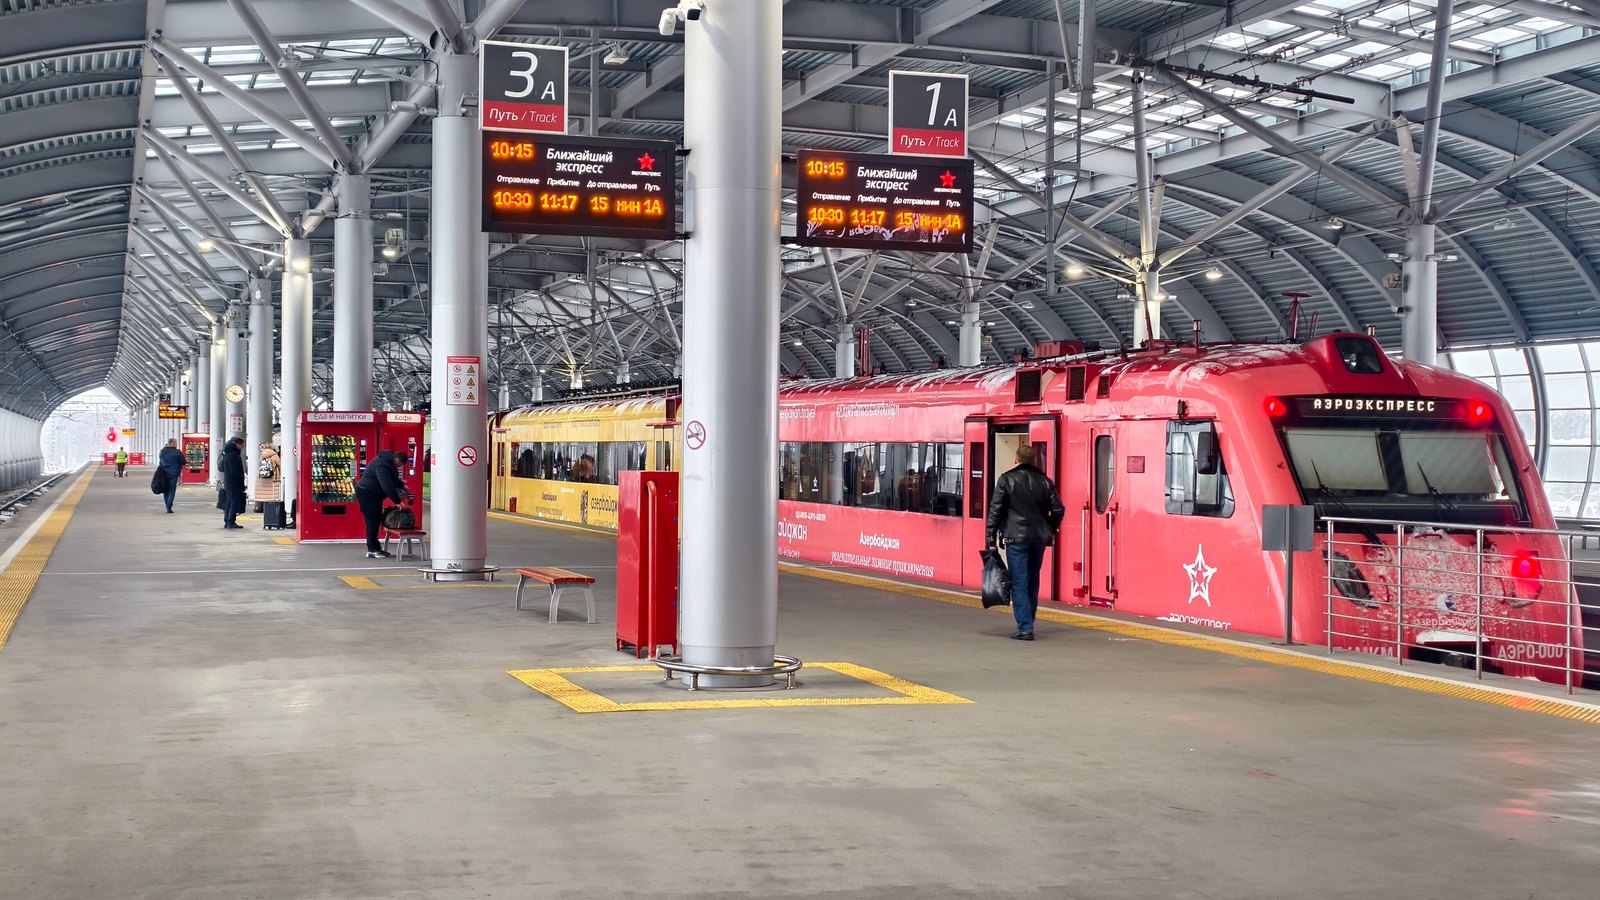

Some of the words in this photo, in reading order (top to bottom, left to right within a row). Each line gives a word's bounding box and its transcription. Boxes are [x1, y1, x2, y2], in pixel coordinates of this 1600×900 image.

[504, 51, 538, 98] 3
[541, 81, 556, 101] А
[925, 82, 942, 126] 1
[944, 108, 957, 127] А
[489, 108, 519, 123] Путь
[521, 110, 527, 121] /
[529, 110, 557, 124] Track
[900, 135, 926, 148] Путь
[928, 136, 933, 146] /
[935, 136, 960, 148] Track
[491, 141, 533, 160] 10:15
[546, 147, 613, 164] Ближайший
[555, 162, 604, 175] экспресс
[806, 160, 846, 176] 10:15
[857, 166, 918, 181] Ближайший
[496, 174, 540, 186] Отправление
[547, 177, 580, 188] Прибытие
[587, 180, 596, 190] До
[597, 181, 638, 191] отправления
[644, 182, 661, 192] Путь
[865, 179, 909, 191] экспресс
[493, 192, 533, 208] 10:30
[540, 194, 578, 210] 11:17
[590, 196, 609, 212] 15
[643, 199, 663, 215] 1А
[812, 192, 851, 202] Отправление
[857, 194, 887, 204] Прибытие
[893, 196, 903, 206] До
[903, 198, 940, 207] отправления
[946, 199, 961, 208] Путь
[809, 207, 843, 222] 10:30
[850, 210, 886, 225] 11:17
[896, 212, 912, 226] 15
[945, 214, 962, 229] 1А
[1313, 398, 1435, 411] АЭРОЭКСПРЕСС
[314, 413, 328, 421] Еда
[394, 414, 413, 422] Кофе
[777, 517, 808, 544] айджан
[859, 530, 900, 551] Азербайджан
[1498, 643, 1568, 660] АЭРО-000
